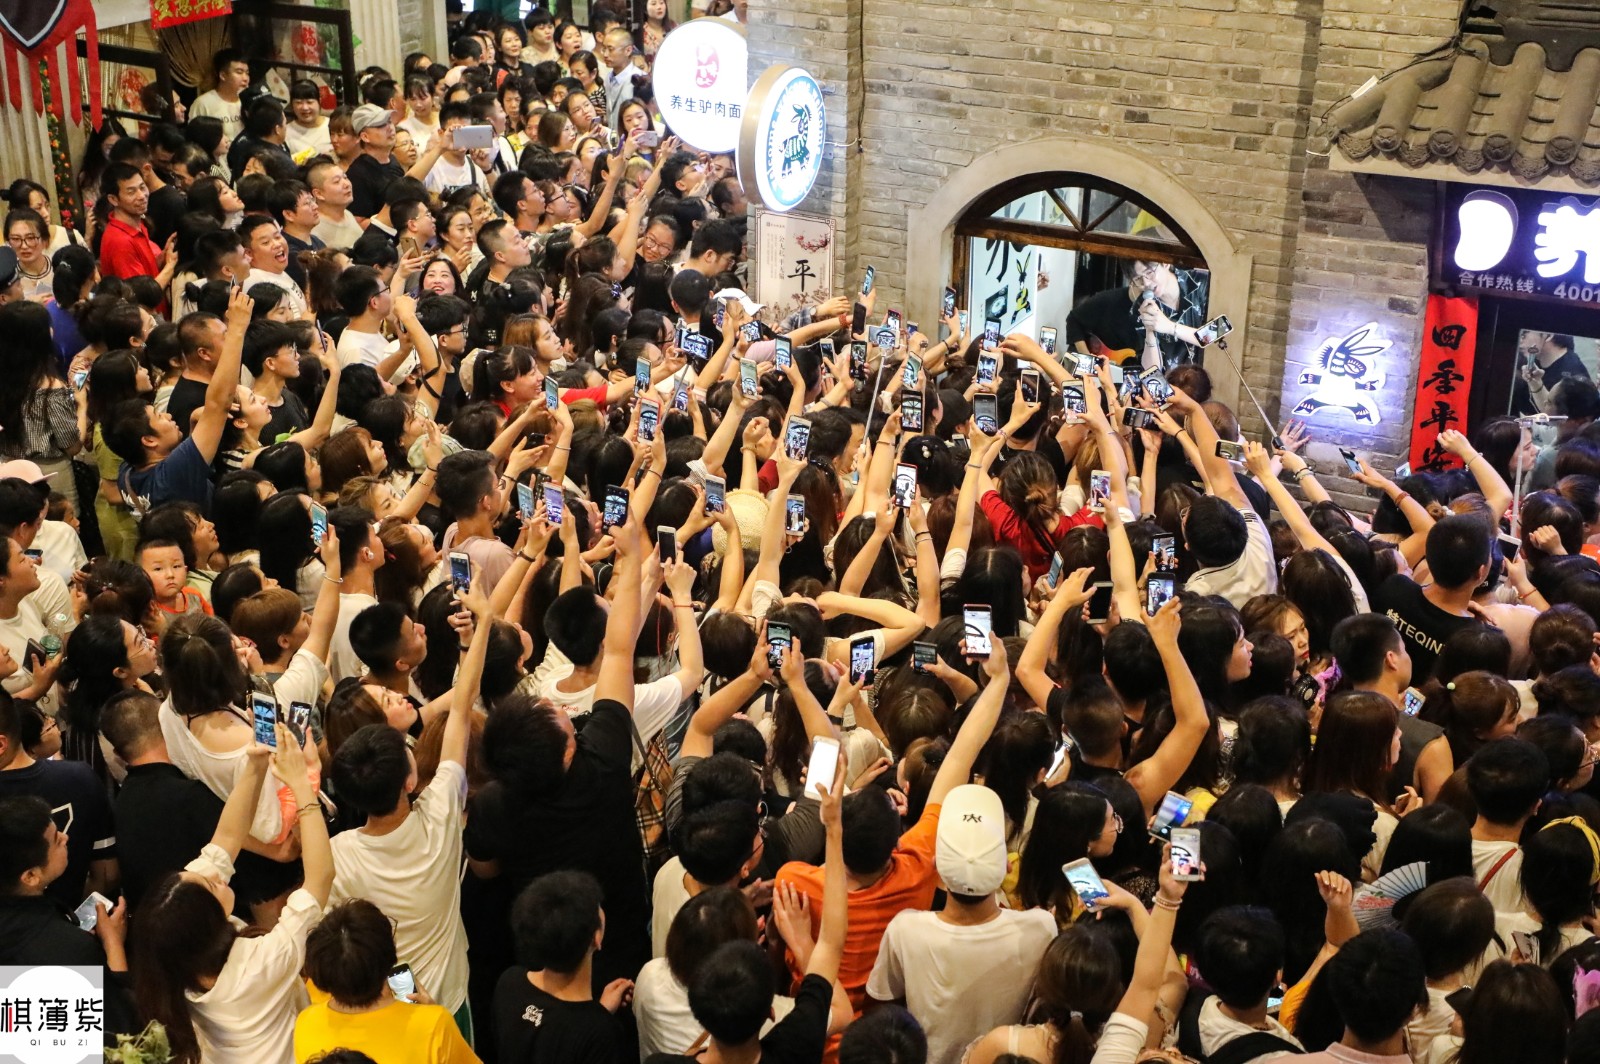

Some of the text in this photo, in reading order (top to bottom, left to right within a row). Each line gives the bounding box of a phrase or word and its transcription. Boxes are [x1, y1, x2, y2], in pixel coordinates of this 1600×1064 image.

[670, 95, 741, 118] 养生驴肉面
[787, 259, 816, 292] 平
[1415, 324, 1467, 472] 四季平安
